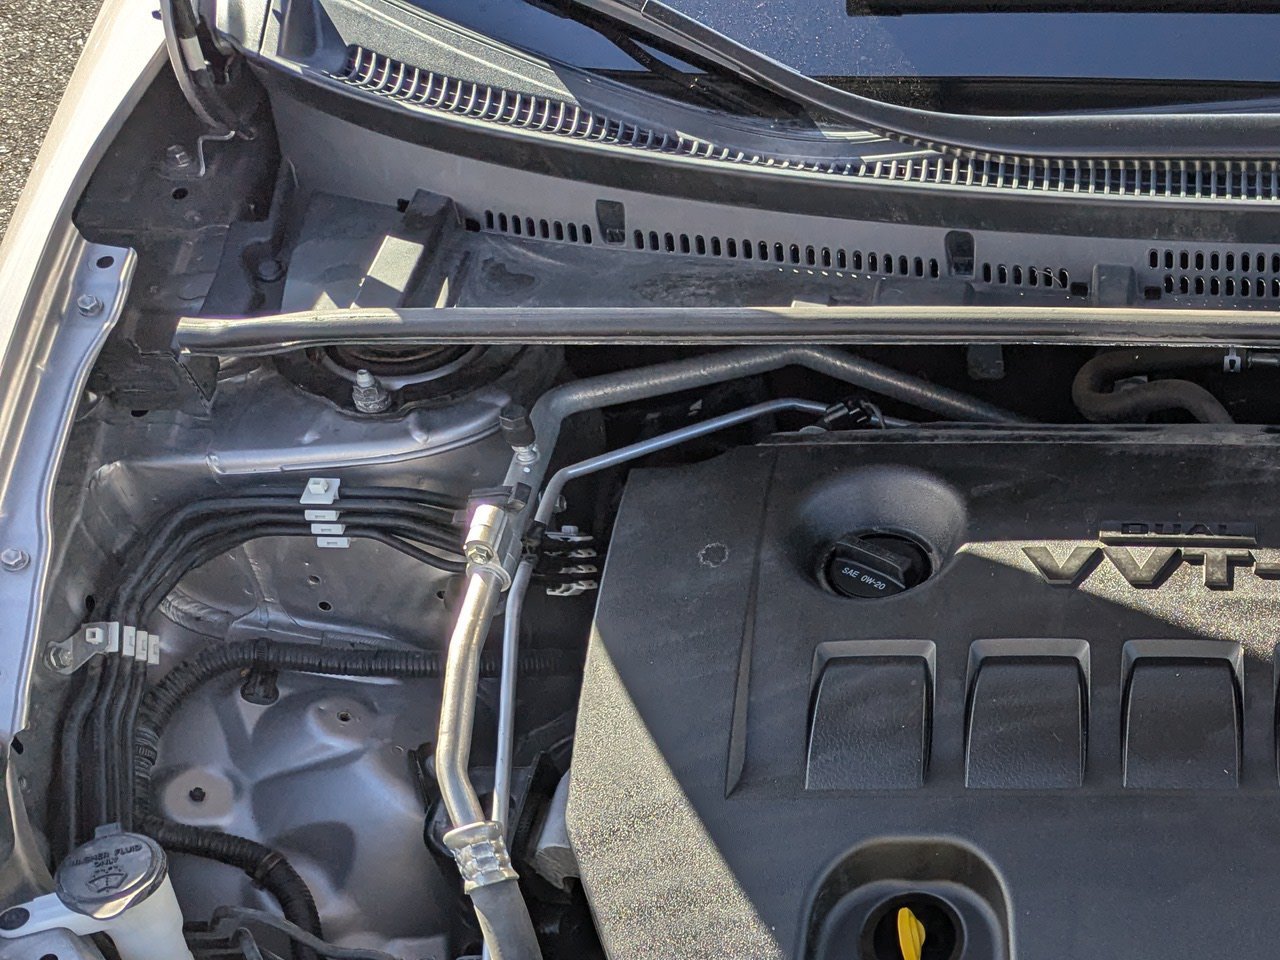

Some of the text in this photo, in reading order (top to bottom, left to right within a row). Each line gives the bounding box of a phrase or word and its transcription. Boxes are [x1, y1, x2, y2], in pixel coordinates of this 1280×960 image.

[1121, 522, 1243, 537] DUAL
[841, 567, 886, 590] SAE 0W-20
[114, 844, 143, 855] FLUID
